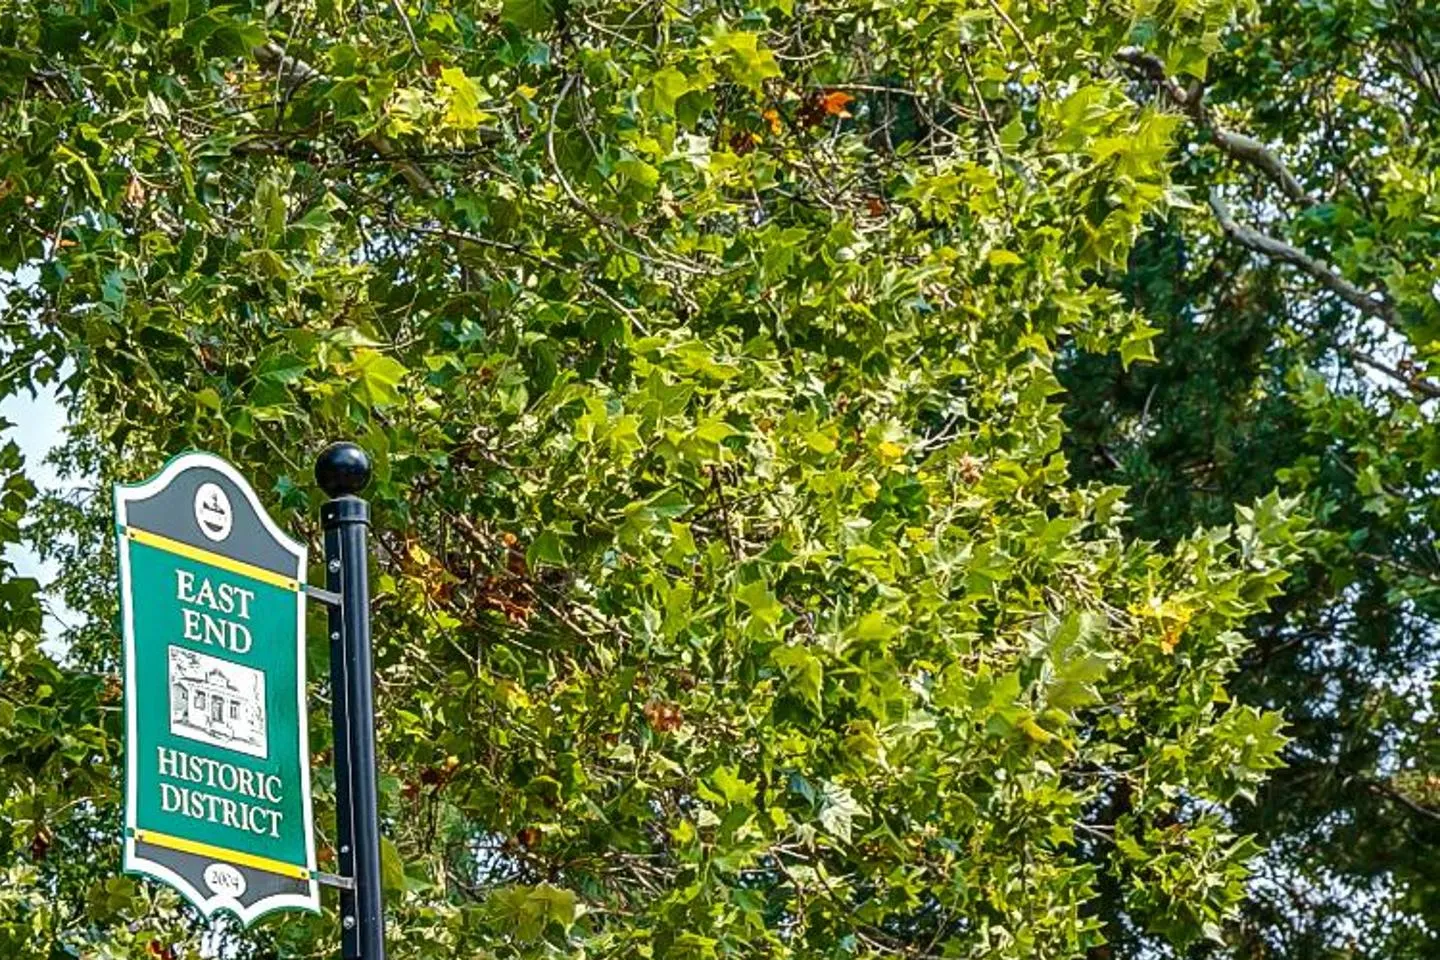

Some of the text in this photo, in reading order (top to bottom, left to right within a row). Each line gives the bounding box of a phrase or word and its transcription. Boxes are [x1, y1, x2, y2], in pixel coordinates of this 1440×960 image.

[175, 569, 255, 619] EAST
[182, 608, 252, 653] END
[157, 746, 283, 803] HISTORIC
[160, 783, 283, 838] DISTRICT
